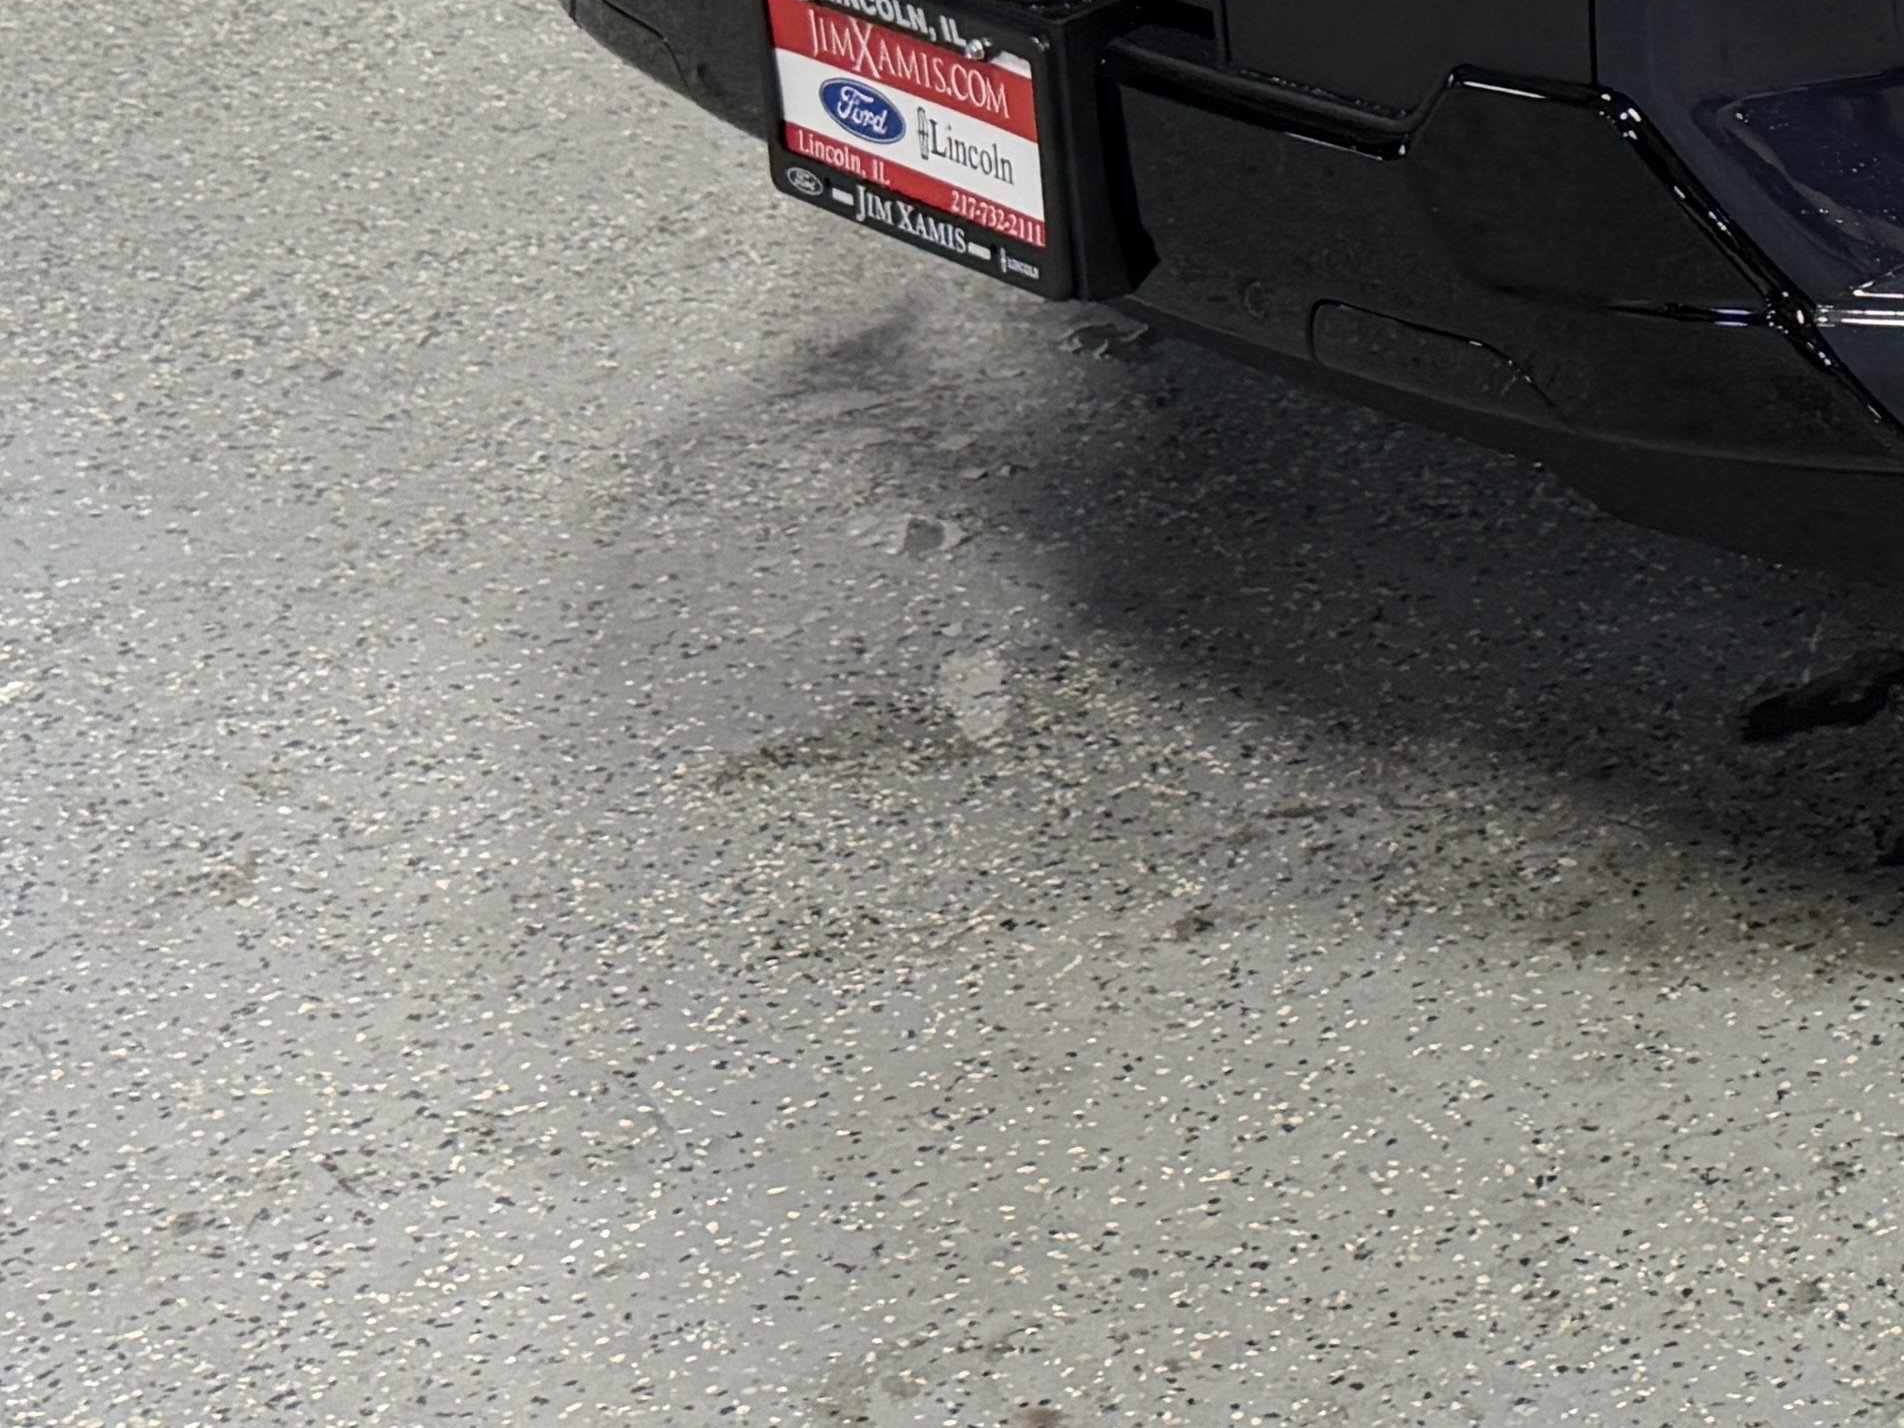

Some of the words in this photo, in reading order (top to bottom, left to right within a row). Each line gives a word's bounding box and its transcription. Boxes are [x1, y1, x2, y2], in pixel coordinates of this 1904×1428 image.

[938, 14, 967, 47] IL
[798, 130, 866, 176] Lincoln,
[871, 159, 891, 186] IL
[837, 85, 888, 136] Ford
[929, 117, 1015, 185] Lincoln
[855, 184, 894, 226] JIM
[895, 199, 969, 254] XAMIS
[949, 190, 1047, 249] 217-732-2111
